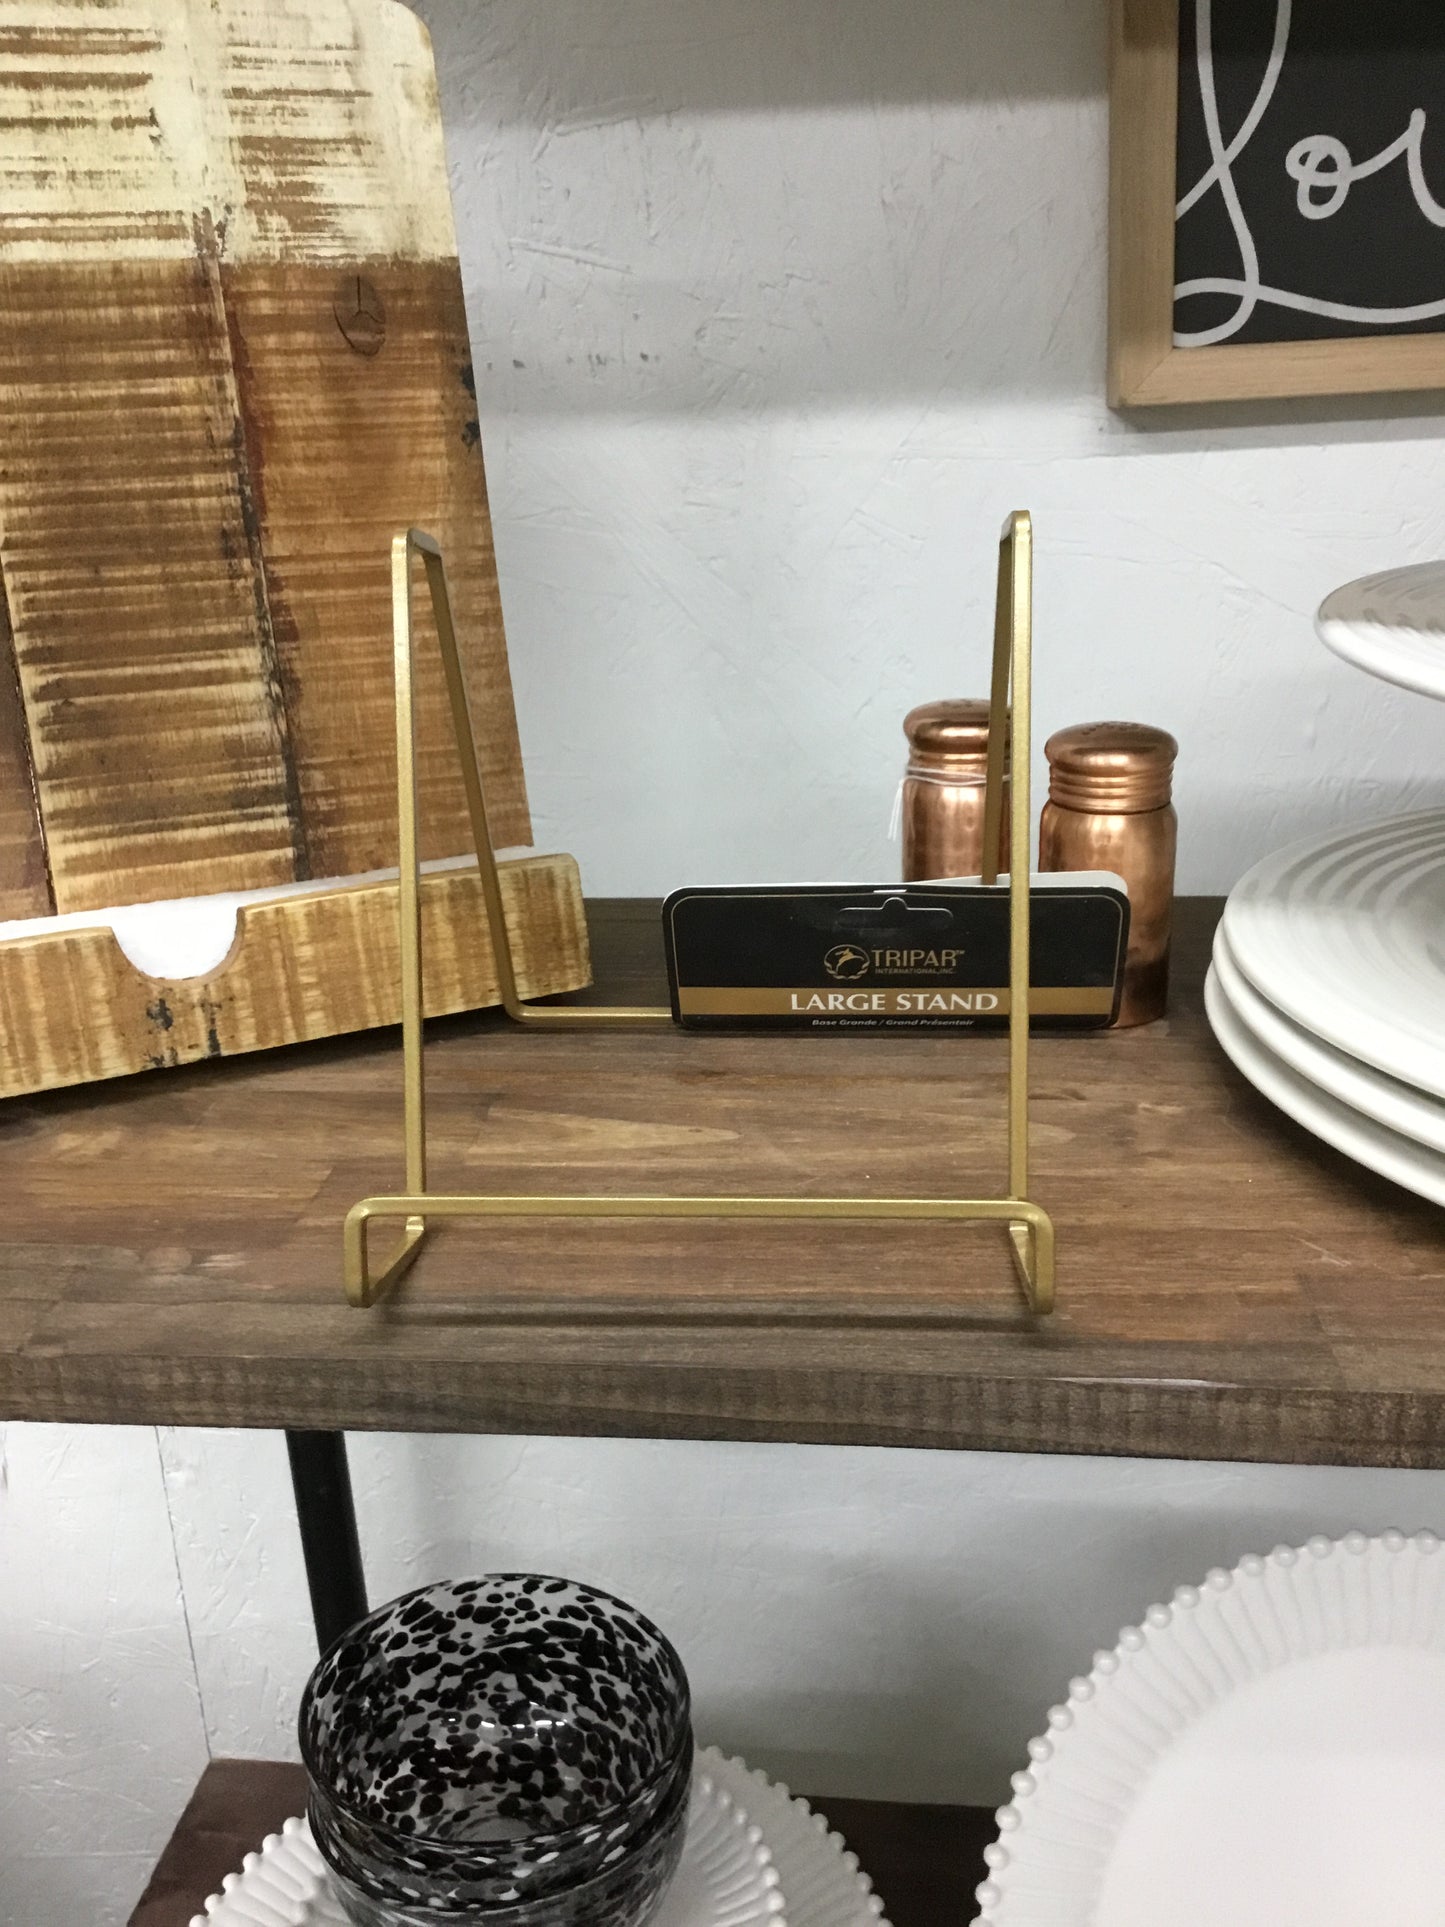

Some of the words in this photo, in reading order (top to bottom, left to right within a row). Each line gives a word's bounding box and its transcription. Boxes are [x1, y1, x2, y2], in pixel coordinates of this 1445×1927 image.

[790, 993, 886, 1011] LARGE
[896, 993, 999, 1011] STAND
[811, 1018, 838, 1026] Base
[839, 1018, 877, 1026] Grande
[886, 1018, 919, 1026] Grand
[919, 1017, 975, 1026] Présentoir
